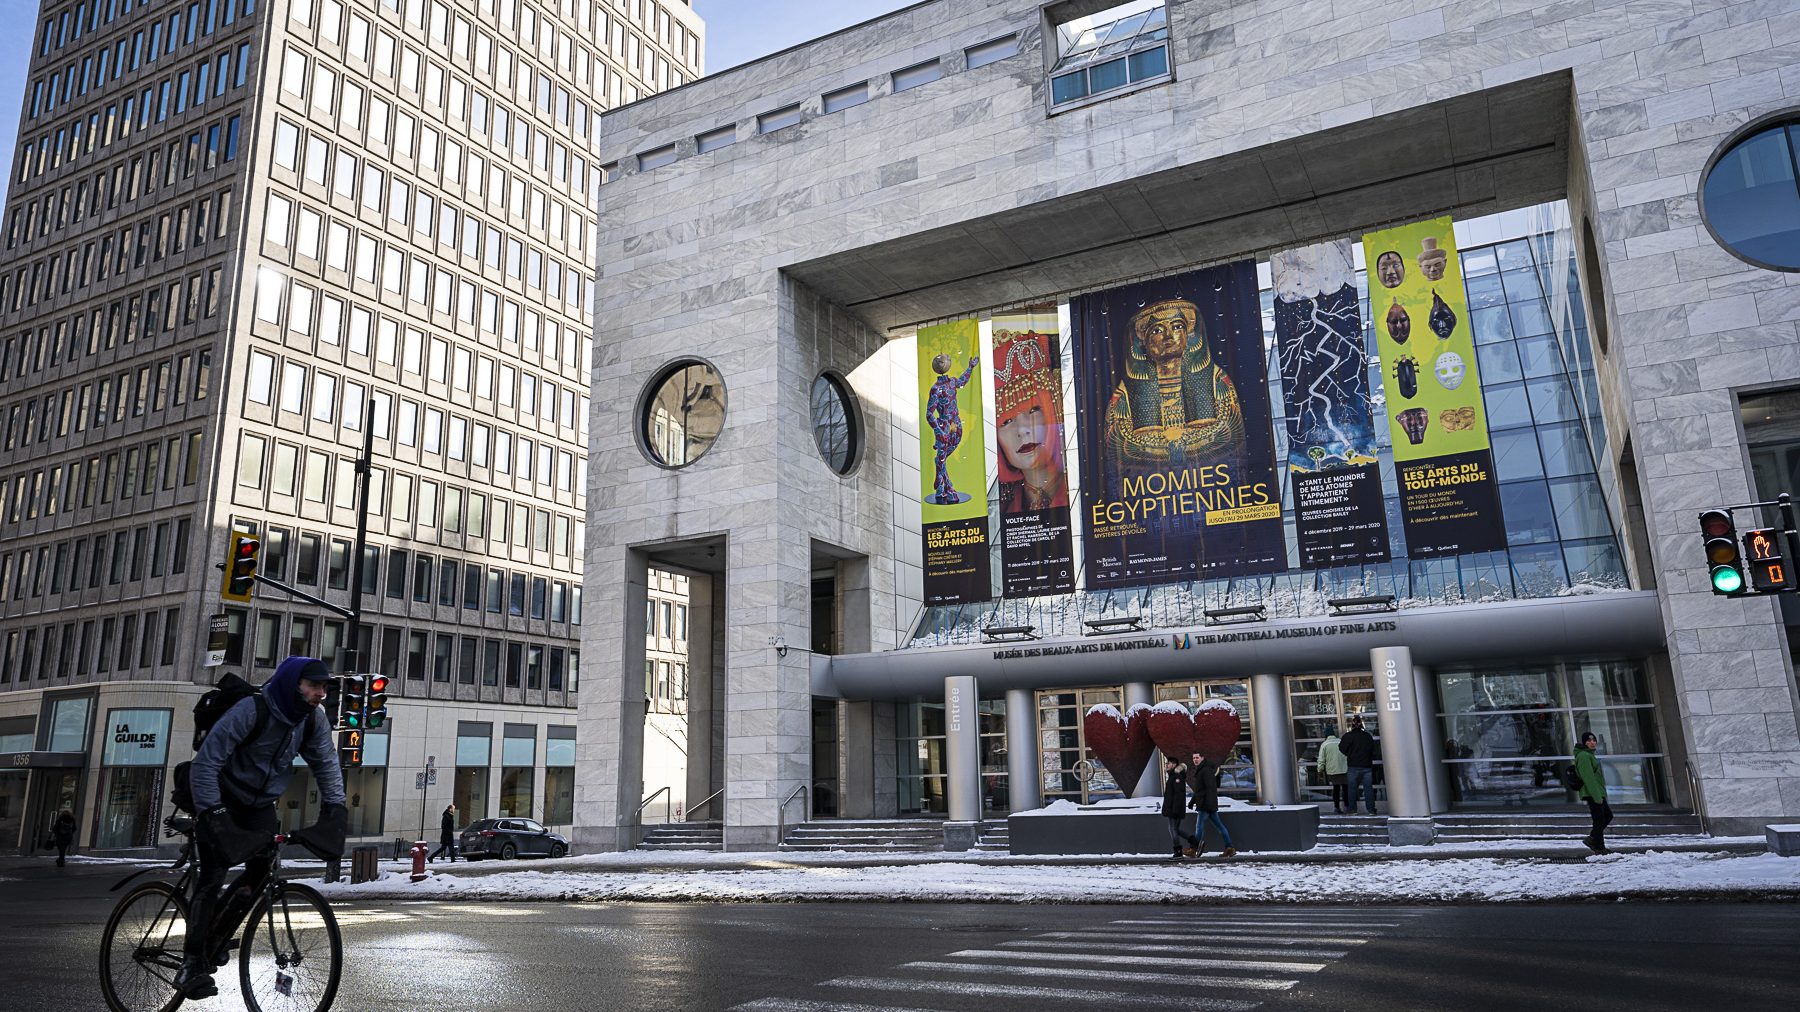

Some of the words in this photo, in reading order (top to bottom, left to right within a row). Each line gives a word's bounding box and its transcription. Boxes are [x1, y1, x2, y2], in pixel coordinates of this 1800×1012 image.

[1333, 473, 1366, 482] MOINDRE
[1404, 471, 1424, 481] LES
[1428, 466, 1458, 478] ARTS
[1461, 463, 1478, 473] DU
[1123, 463, 1230, 498] MOMIES
[1405, 472, 1486, 490] TOUT-MONDE
[1326, 482, 1353, 491] ATOMES
[1092, 483, 1269, 526] ÉGYPTIENNES
[1231, 504, 1278, 515] PROLONGATION
[1006, 515, 1039, 524] VOLTE-FACE
[1208, 515, 1235, 524] JUSQU'AU
[944, 529, 966, 538] ARTS
[1094, 525, 1110, 533] PASSÉ
[1094, 530, 1120, 539] MYSTÈRES
[1121, 528, 1146, 536] DÉVOILÉS
[928, 535, 984, 548] TOUT-MONDE
[993, 647, 1023, 660] MUSÉE
[1024, 647, 1041, 658] DES
[1042, 643, 1098, 656] BEAUX-ARTS
[1100, 642, 1113, 652] DE
[1114, 638, 1168, 651] MONTRÉAL
[1195, 635, 1216, 644] THE
[1217, 630, 1274, 643] MONTREAL
[1276, 626, 1322, 639] MUSEUM
[1324, 625, 1338, 635] OF
[1339, 624, 1364, 634] FINE
[1366, 621, 1396, 633] ARTS
[1383, 659, 1400, 711] Entrée
[950, 687, 960, 732] Entrée
[116, 724, 129, 733] LA
[115, 733, 156, 743] GUILDE
[13, 754, 29, 765] 1356
